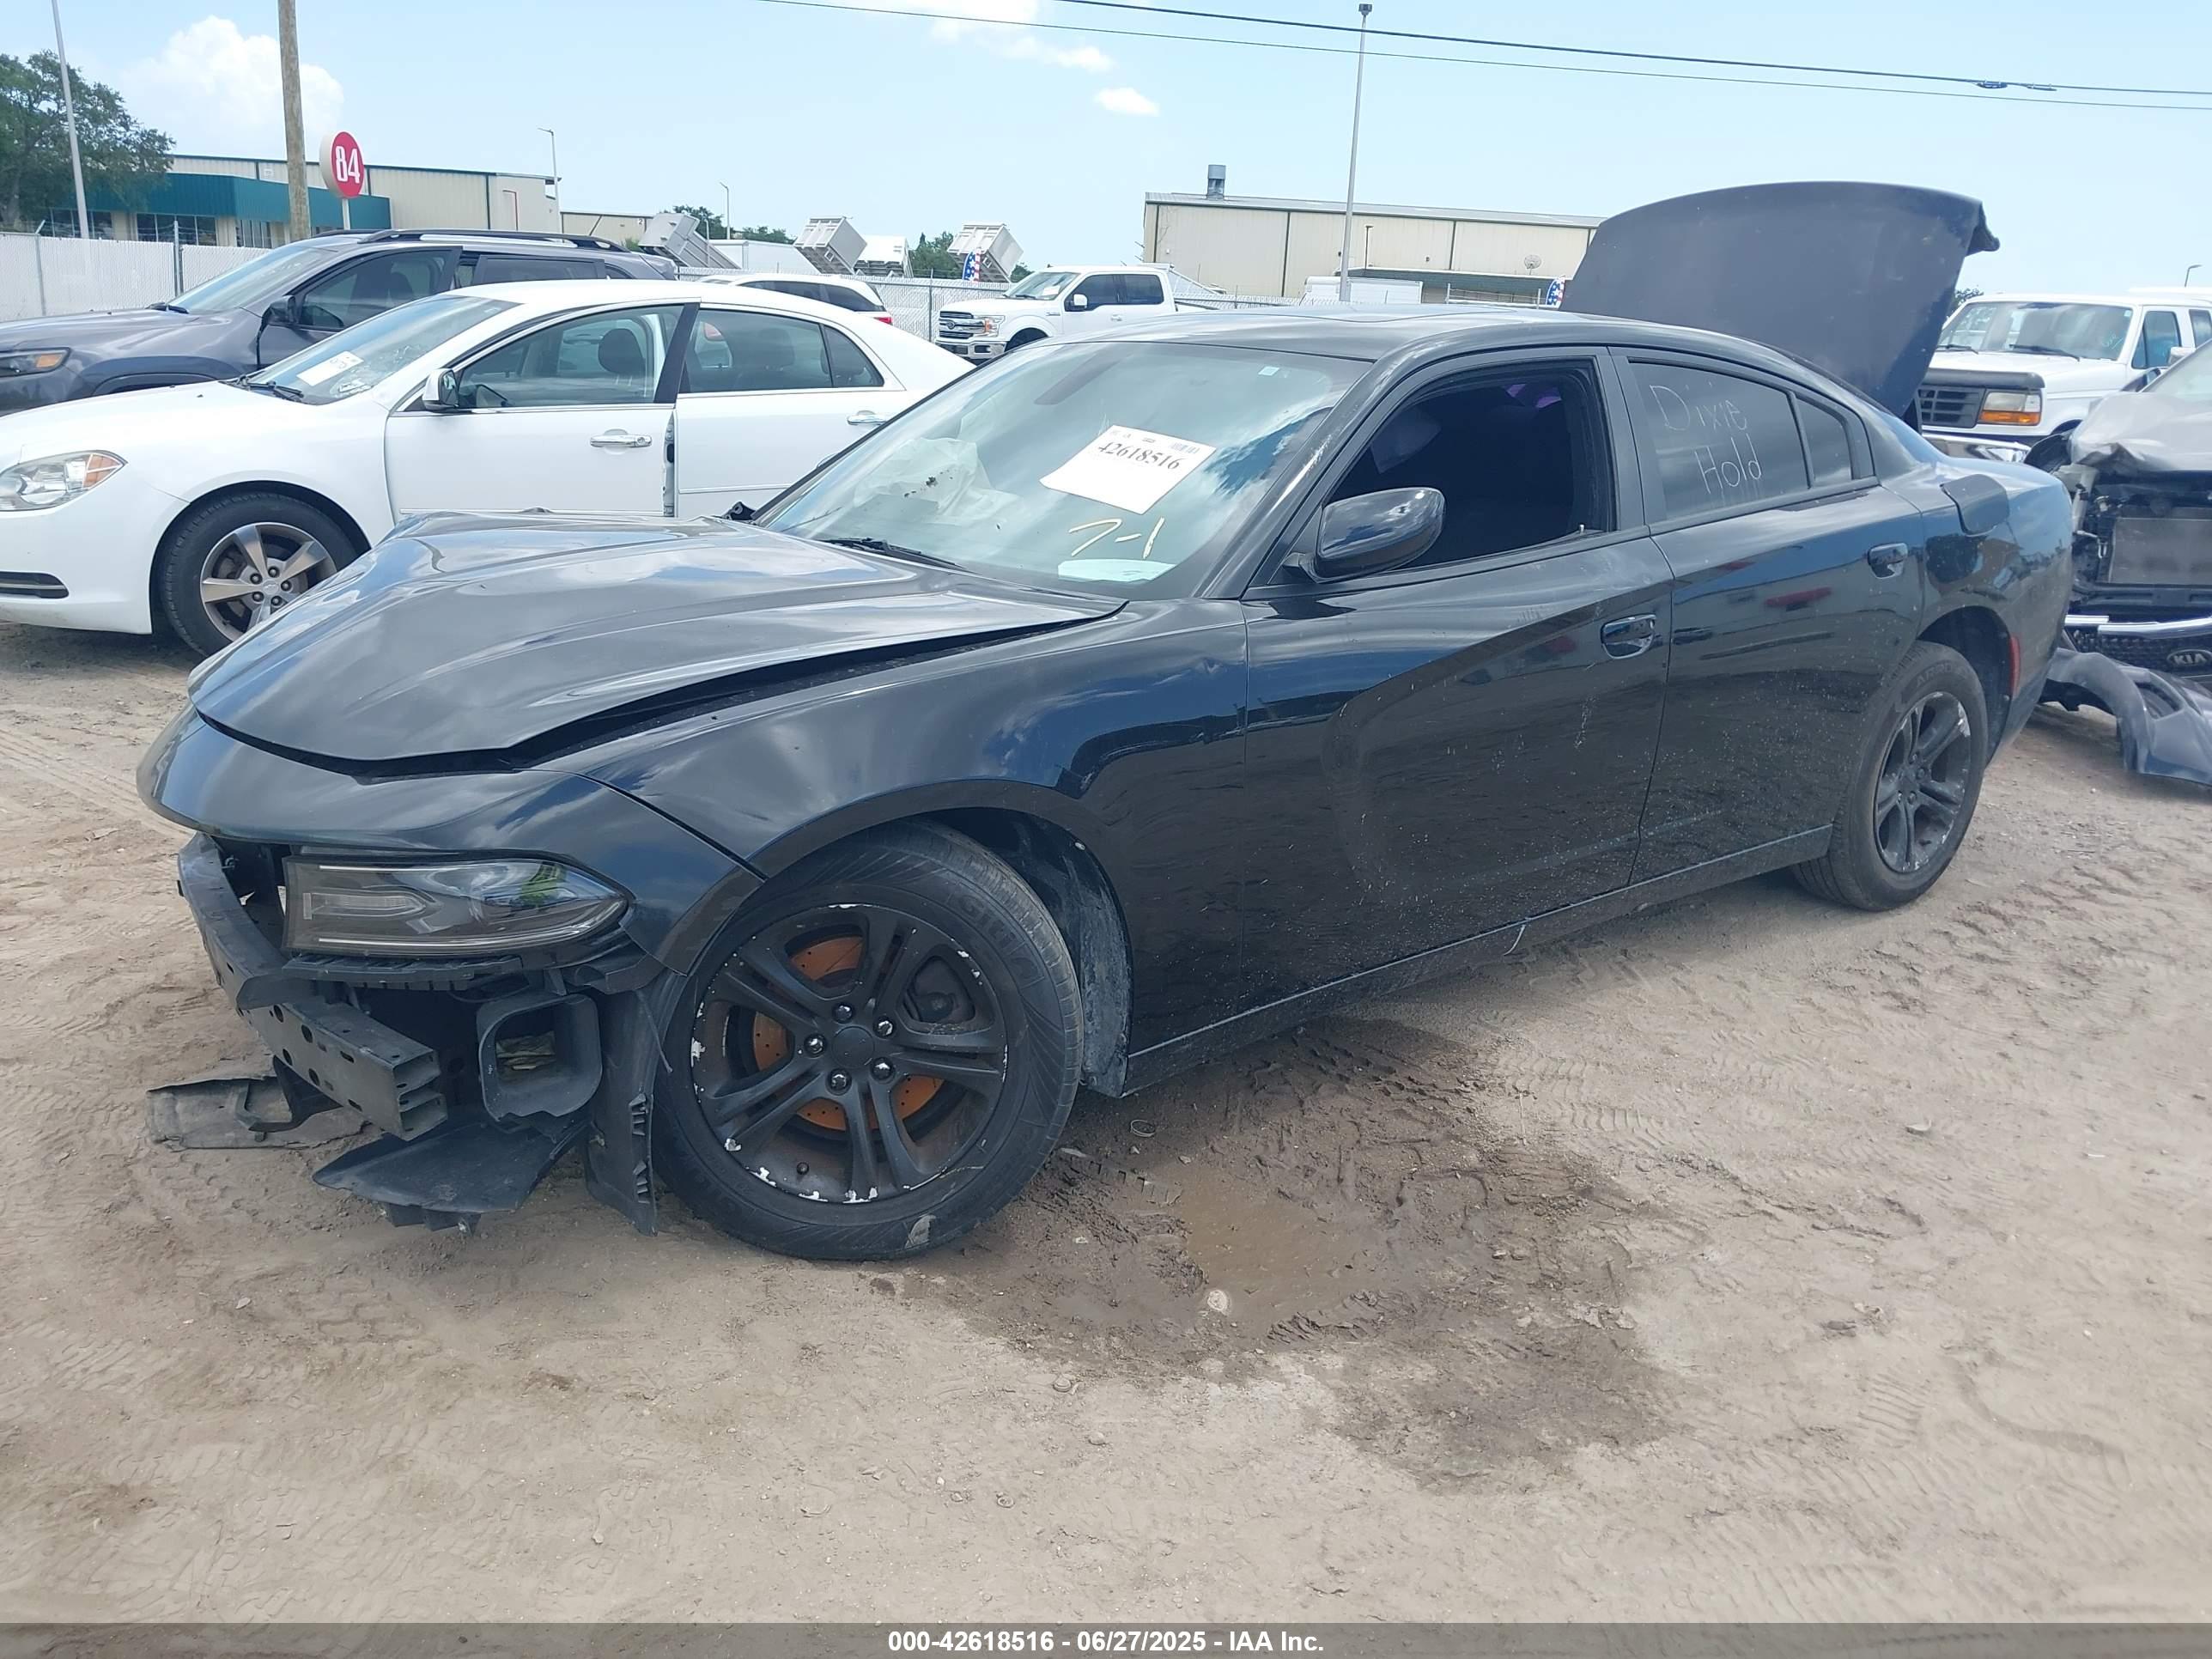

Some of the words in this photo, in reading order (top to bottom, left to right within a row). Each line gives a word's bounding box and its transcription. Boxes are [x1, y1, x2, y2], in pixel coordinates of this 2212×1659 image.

[335, 145, 361, 184] 84
[1098, 441, 1184, 470] 42618516
[1693, 432, 1762, 495] Hold
[1067, 517, 1165, 560] 7-1
[2173, 653, 2208, 665] KIA
